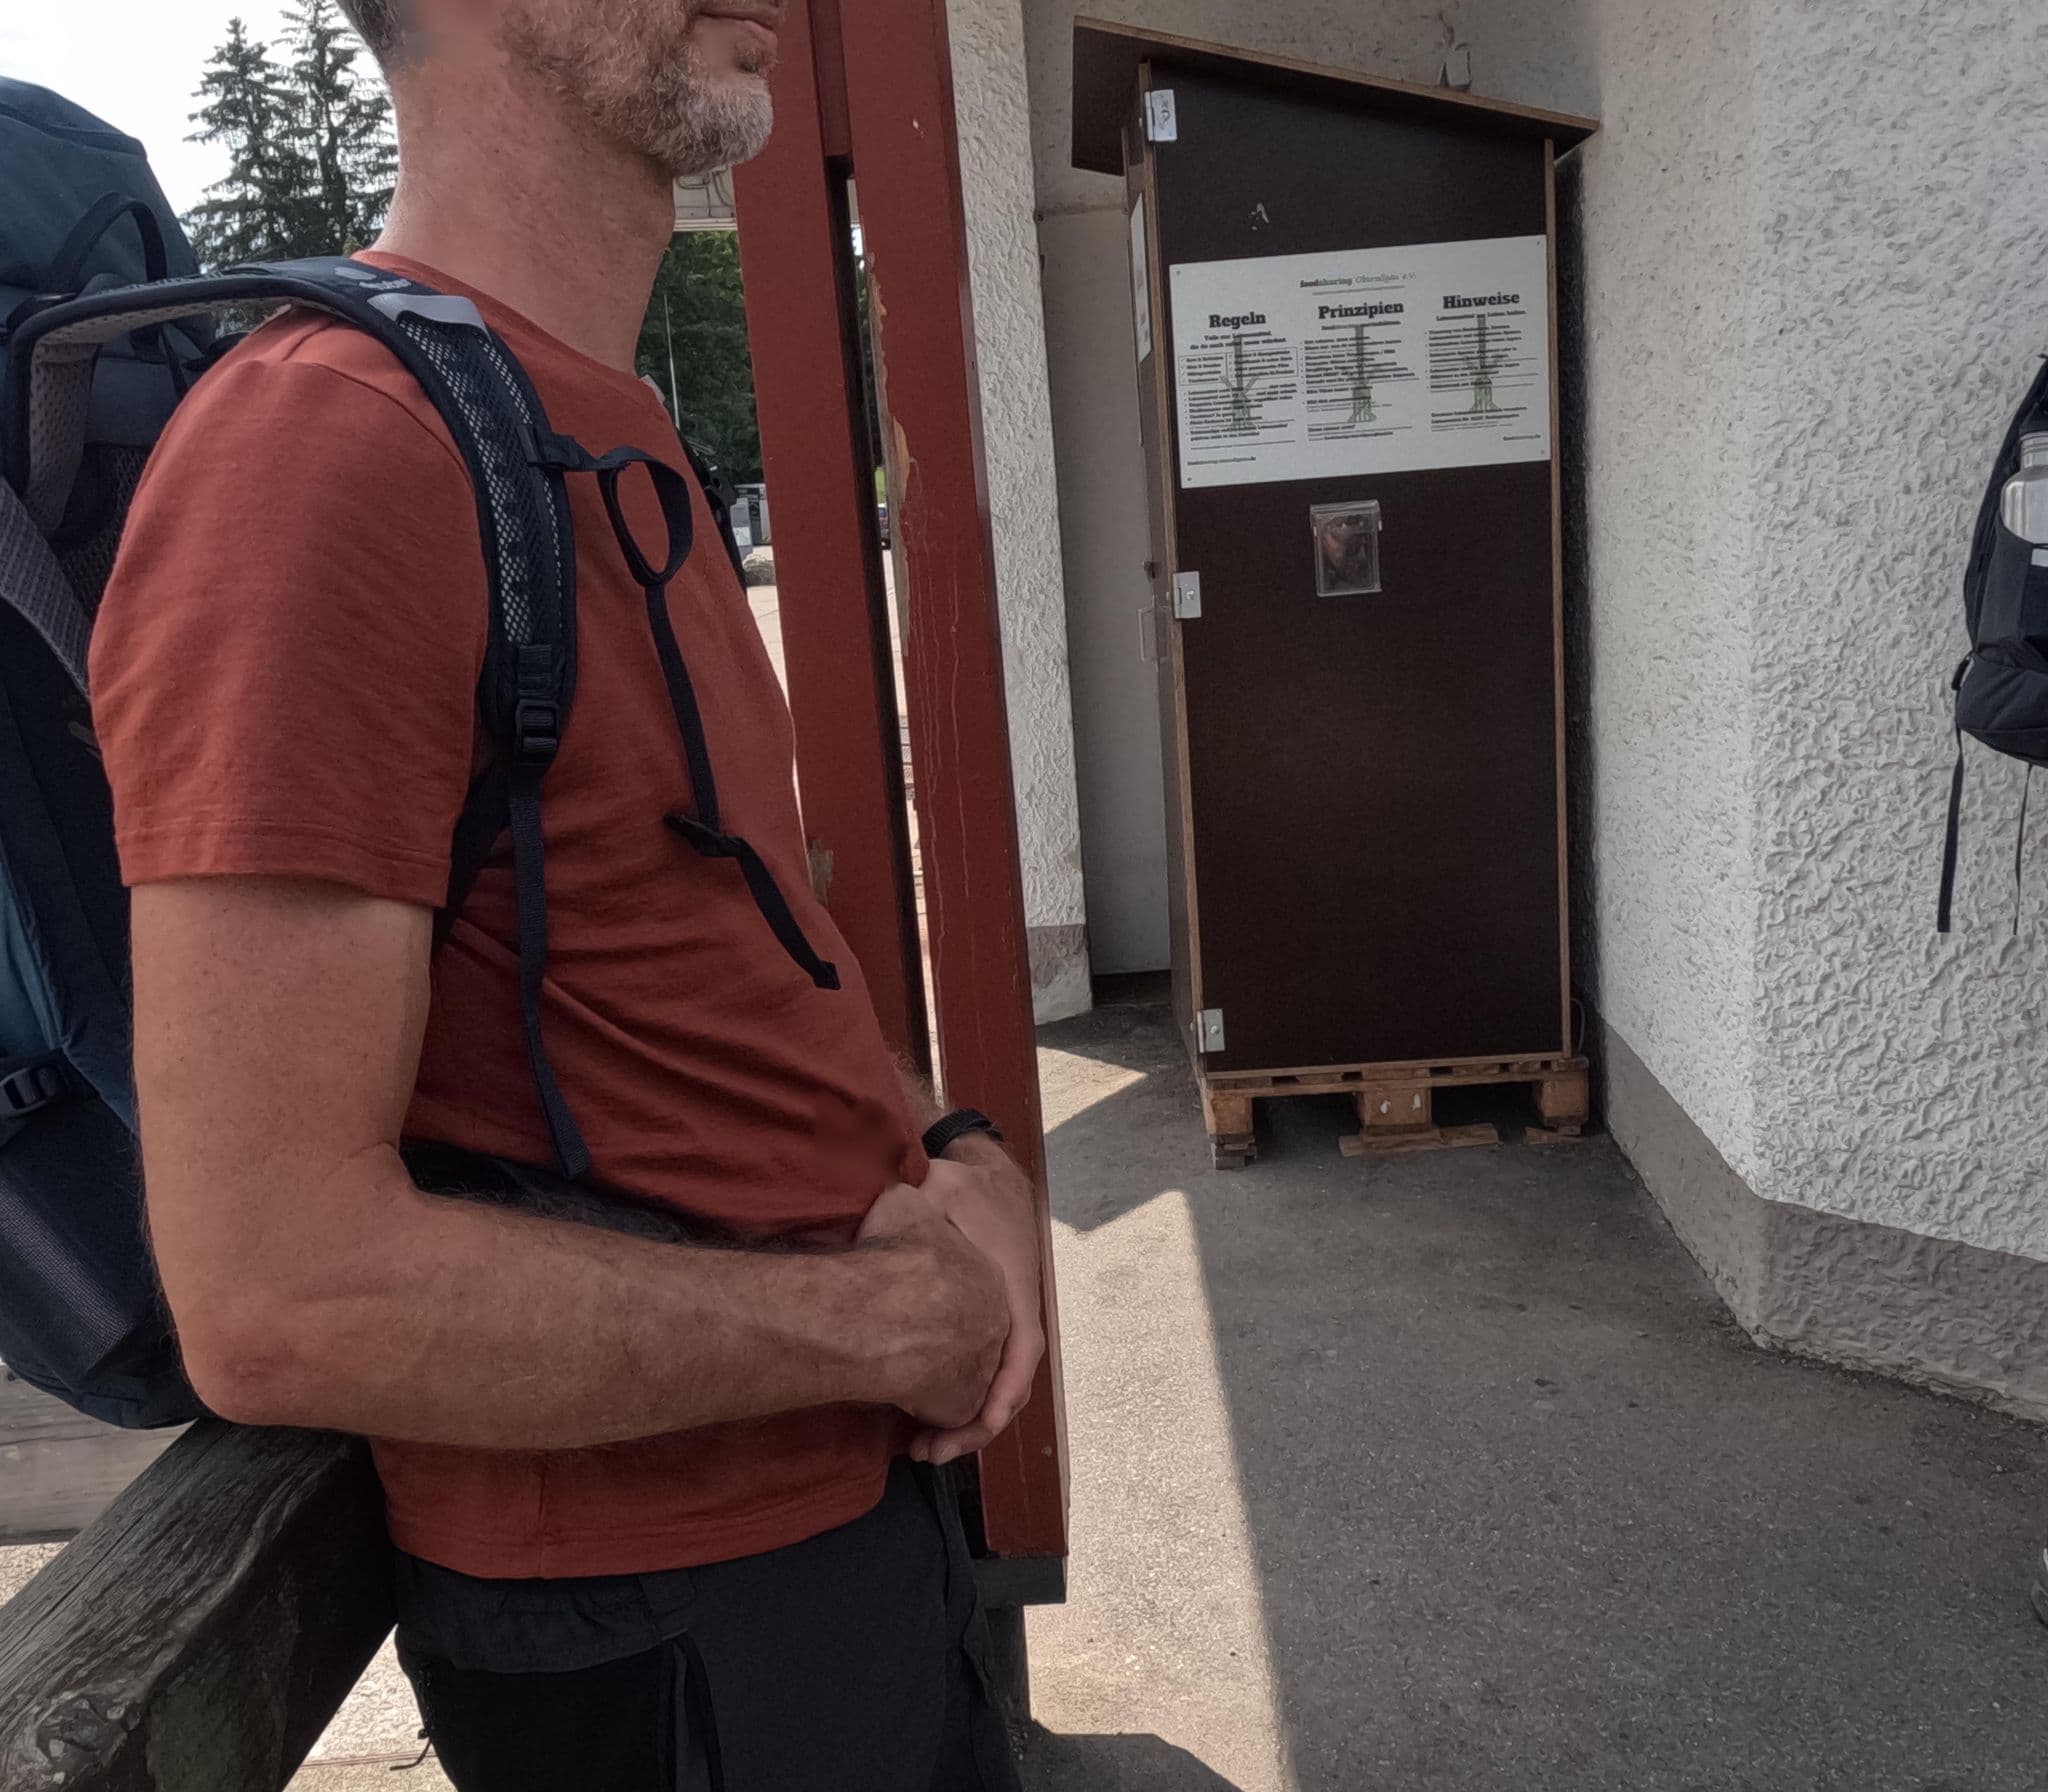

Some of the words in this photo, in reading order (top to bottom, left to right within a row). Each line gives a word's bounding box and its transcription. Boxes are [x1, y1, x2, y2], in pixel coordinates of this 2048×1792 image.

[1443, 291, 1520, 309] Hinweise
[1318, 301, 1404, 319] Prinzipien
[1209, 311, 1266, 329] Regeln
